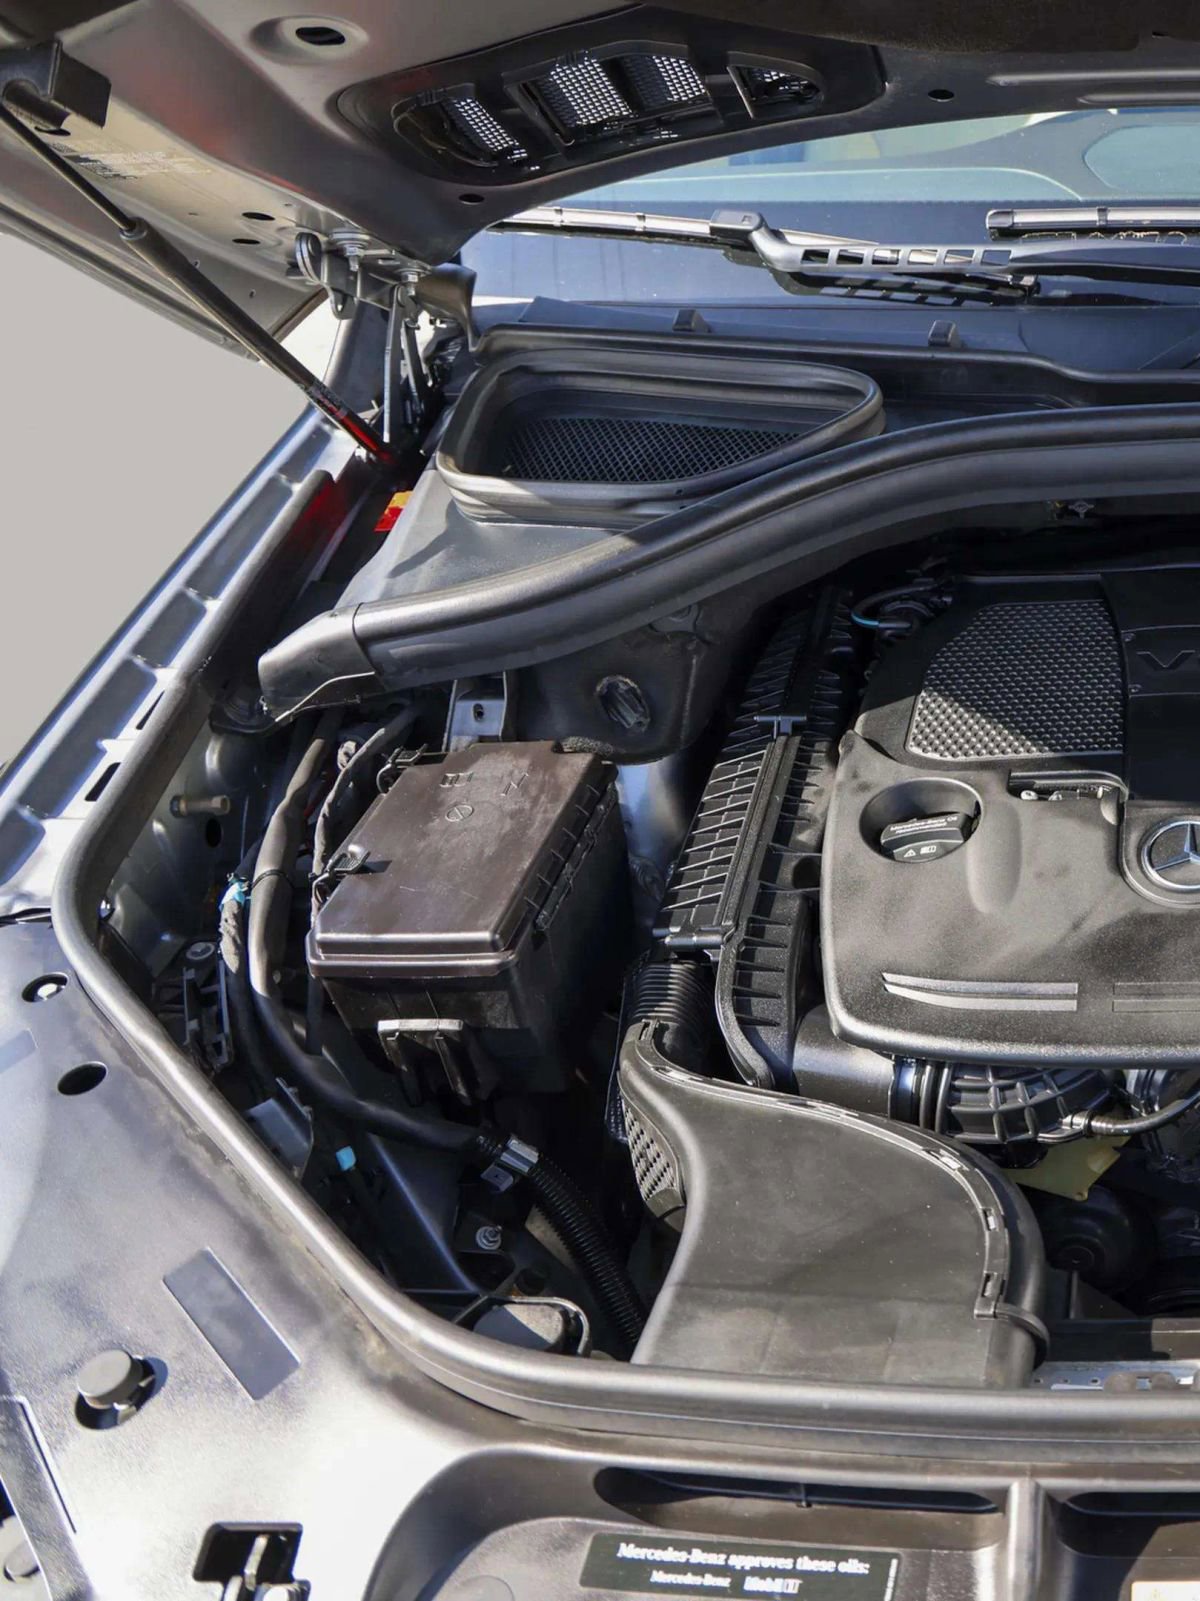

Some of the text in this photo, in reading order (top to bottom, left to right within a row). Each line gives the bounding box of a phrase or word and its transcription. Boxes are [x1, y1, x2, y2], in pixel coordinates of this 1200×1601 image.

[616, 1543, 870, 1575] Mercedes-Benz approves these oils:
[649, 1570, 731, 1588] Mercedes-Benz
